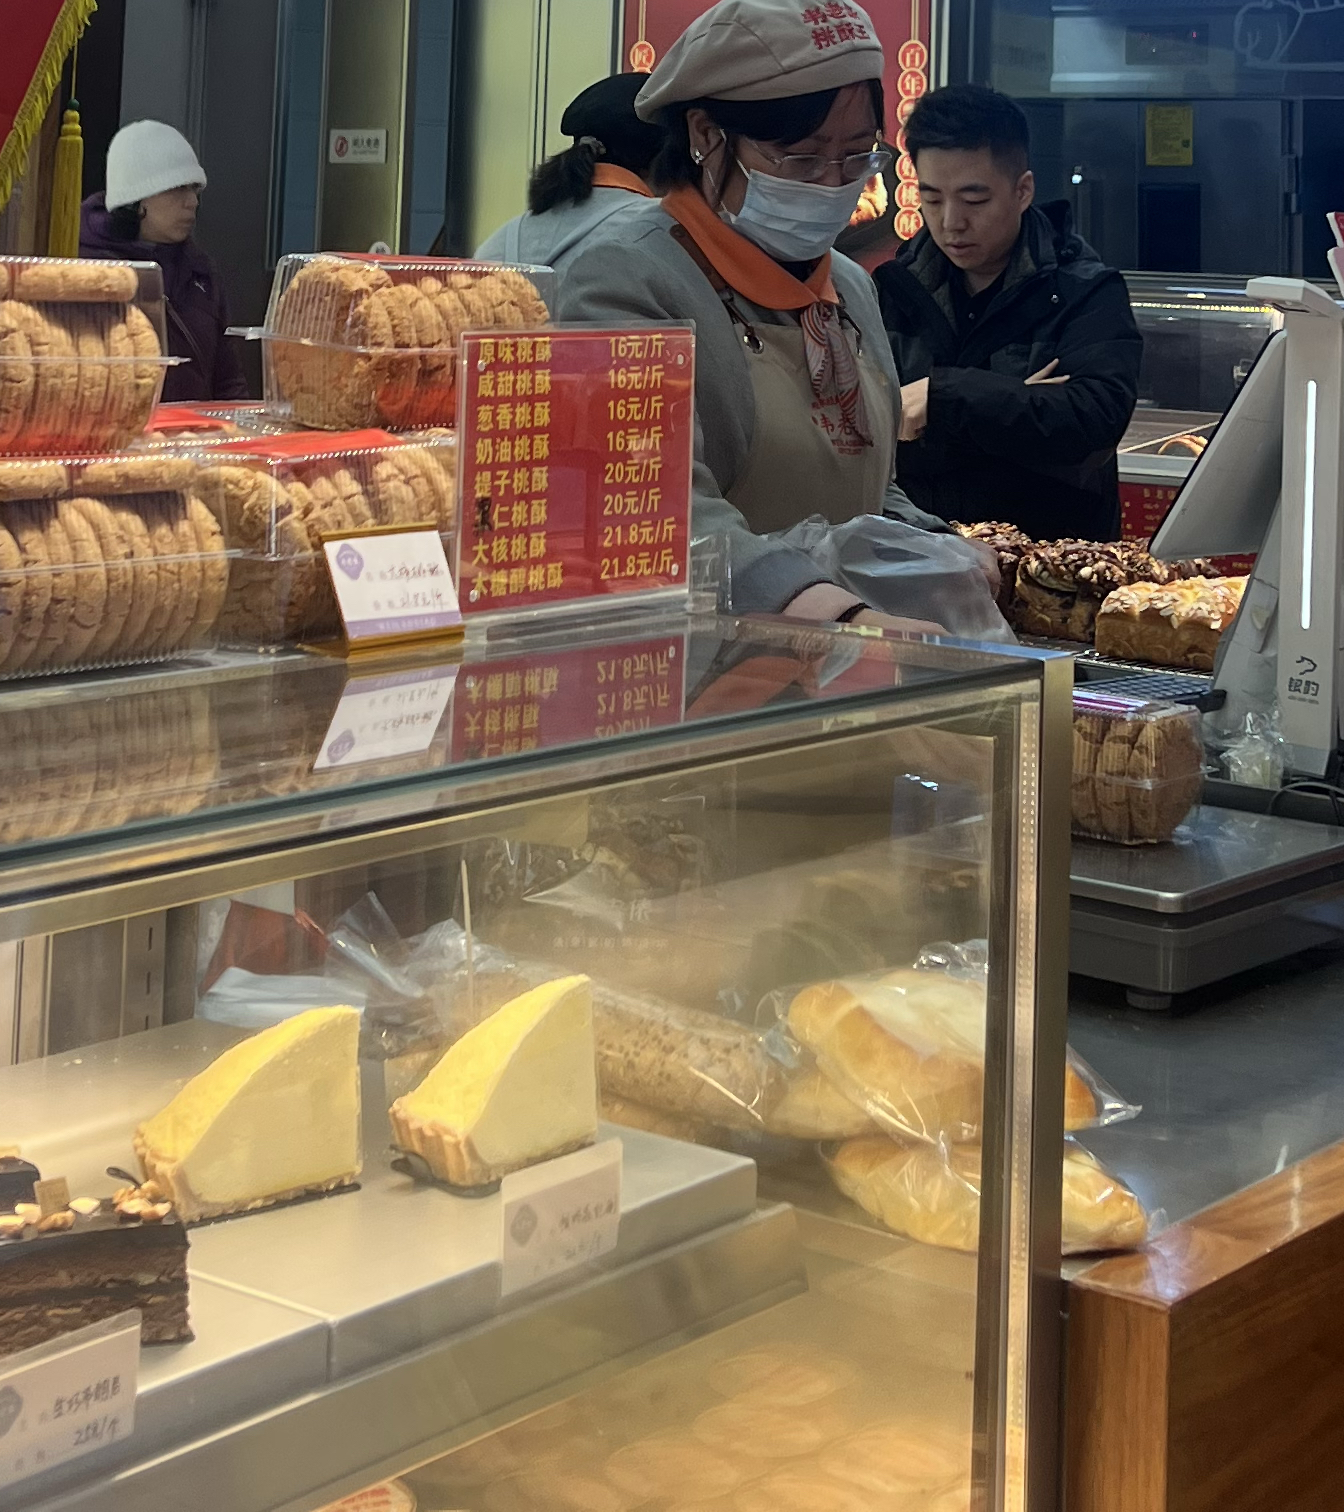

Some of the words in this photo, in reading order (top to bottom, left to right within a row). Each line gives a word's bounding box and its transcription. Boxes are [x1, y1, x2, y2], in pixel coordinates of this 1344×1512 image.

[478, 336, 552, 366] 原味桃酥
[608, 333, 665, 359] 16元/斤
[476, 368, 552, 399] 咸甜桃酥
[607, 364, 665, 390] 16元/斤
[476, 400, 551, 433] 葱香桃酥
[607, 395, 664, 422] 16元/斤
[475, 433, 550, 466] 奶油桃酥
[606, 425, 664, 453] 16元/斤
[474, 466, 549, 499] 提子桃酥
[604, 456, 662, 485] 20元/斤
[474, 496, 548, 537] 仁桃酥
[603, 487, 662, 517] 20元/斤
[471, 530, 547, 567] 大核桃酥
[603, 517, 677, 548] 21.8元/斤
[600, 548, 674, 581] 21.8元/斤
